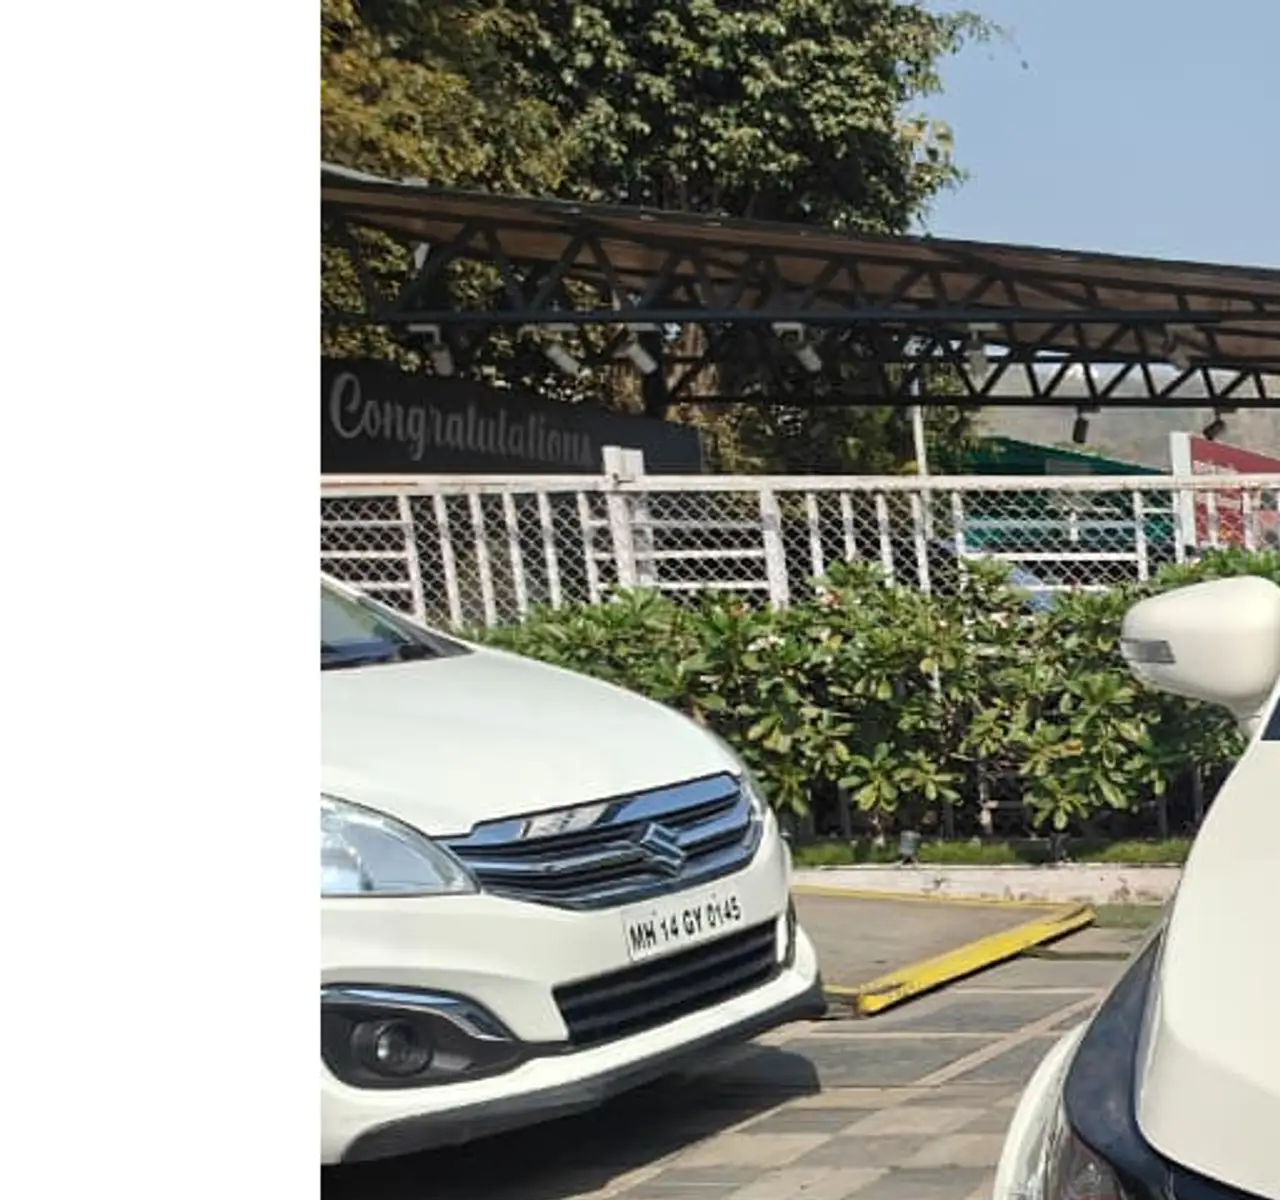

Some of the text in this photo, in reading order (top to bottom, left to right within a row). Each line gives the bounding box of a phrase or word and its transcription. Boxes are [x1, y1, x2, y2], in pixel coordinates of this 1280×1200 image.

[330, 372, 594, 467] Congratulations
[629, 920, 656, 952] MH
[660, 914, 679, 942] 14
